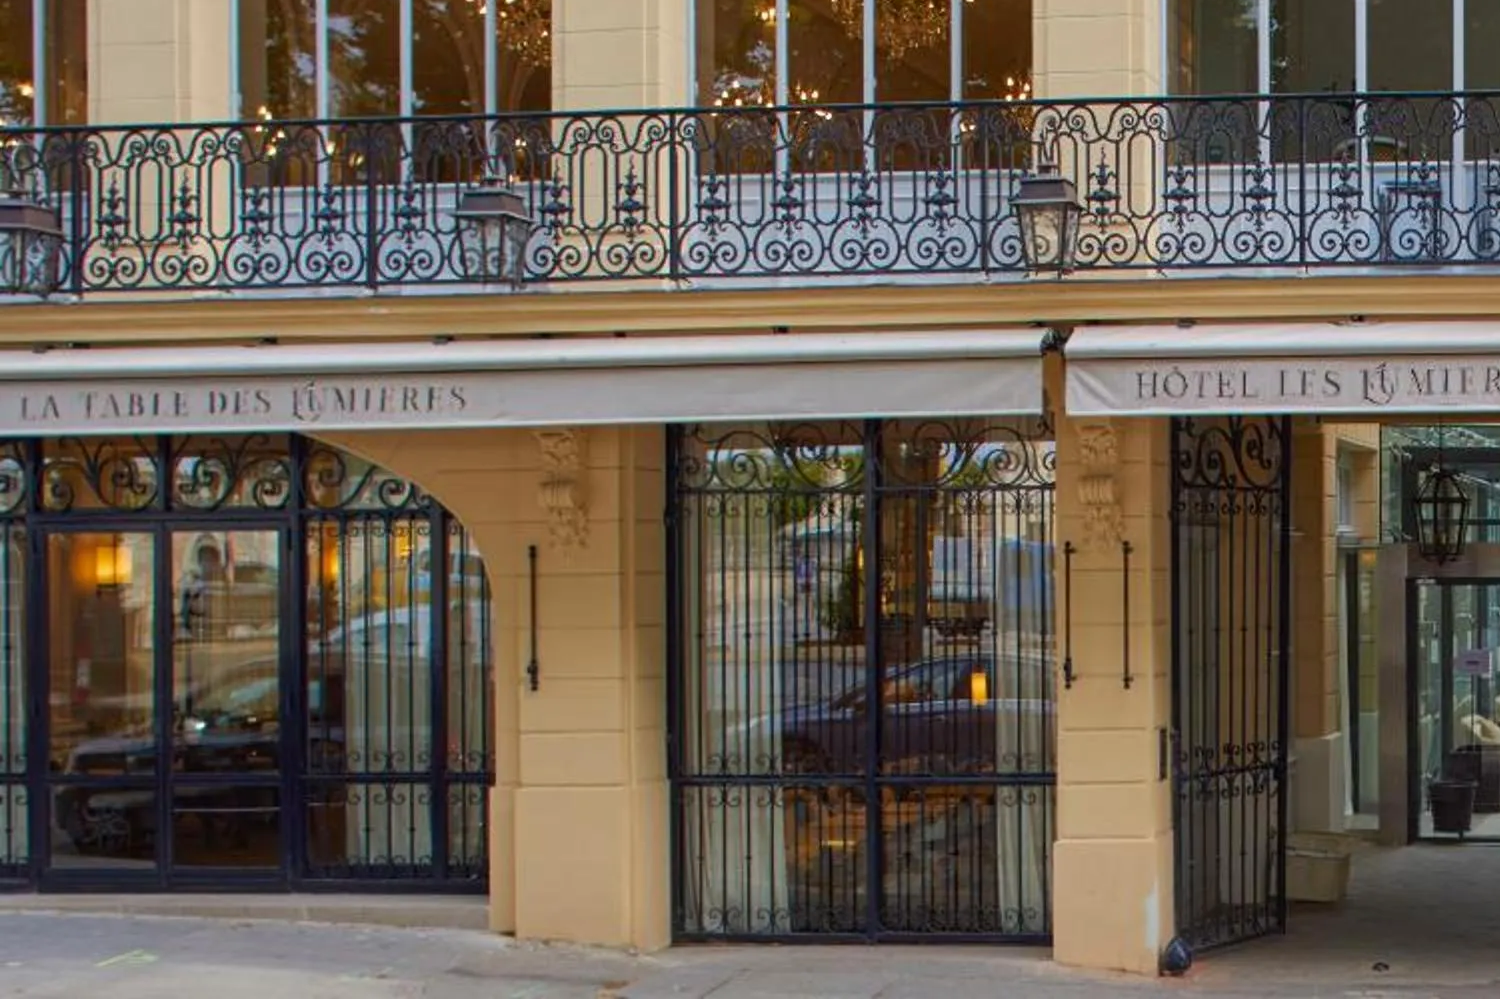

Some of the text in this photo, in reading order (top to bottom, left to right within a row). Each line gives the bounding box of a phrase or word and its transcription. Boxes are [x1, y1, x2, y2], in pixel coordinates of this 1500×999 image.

[1135, 365, 1260, 399] HÔTEL
[1277, 367, 1342, 398] LES
[20, 393, 60, 421] LA
[81, 389, 190, 419] TABLE
[205, 389, 272, 416] DES
